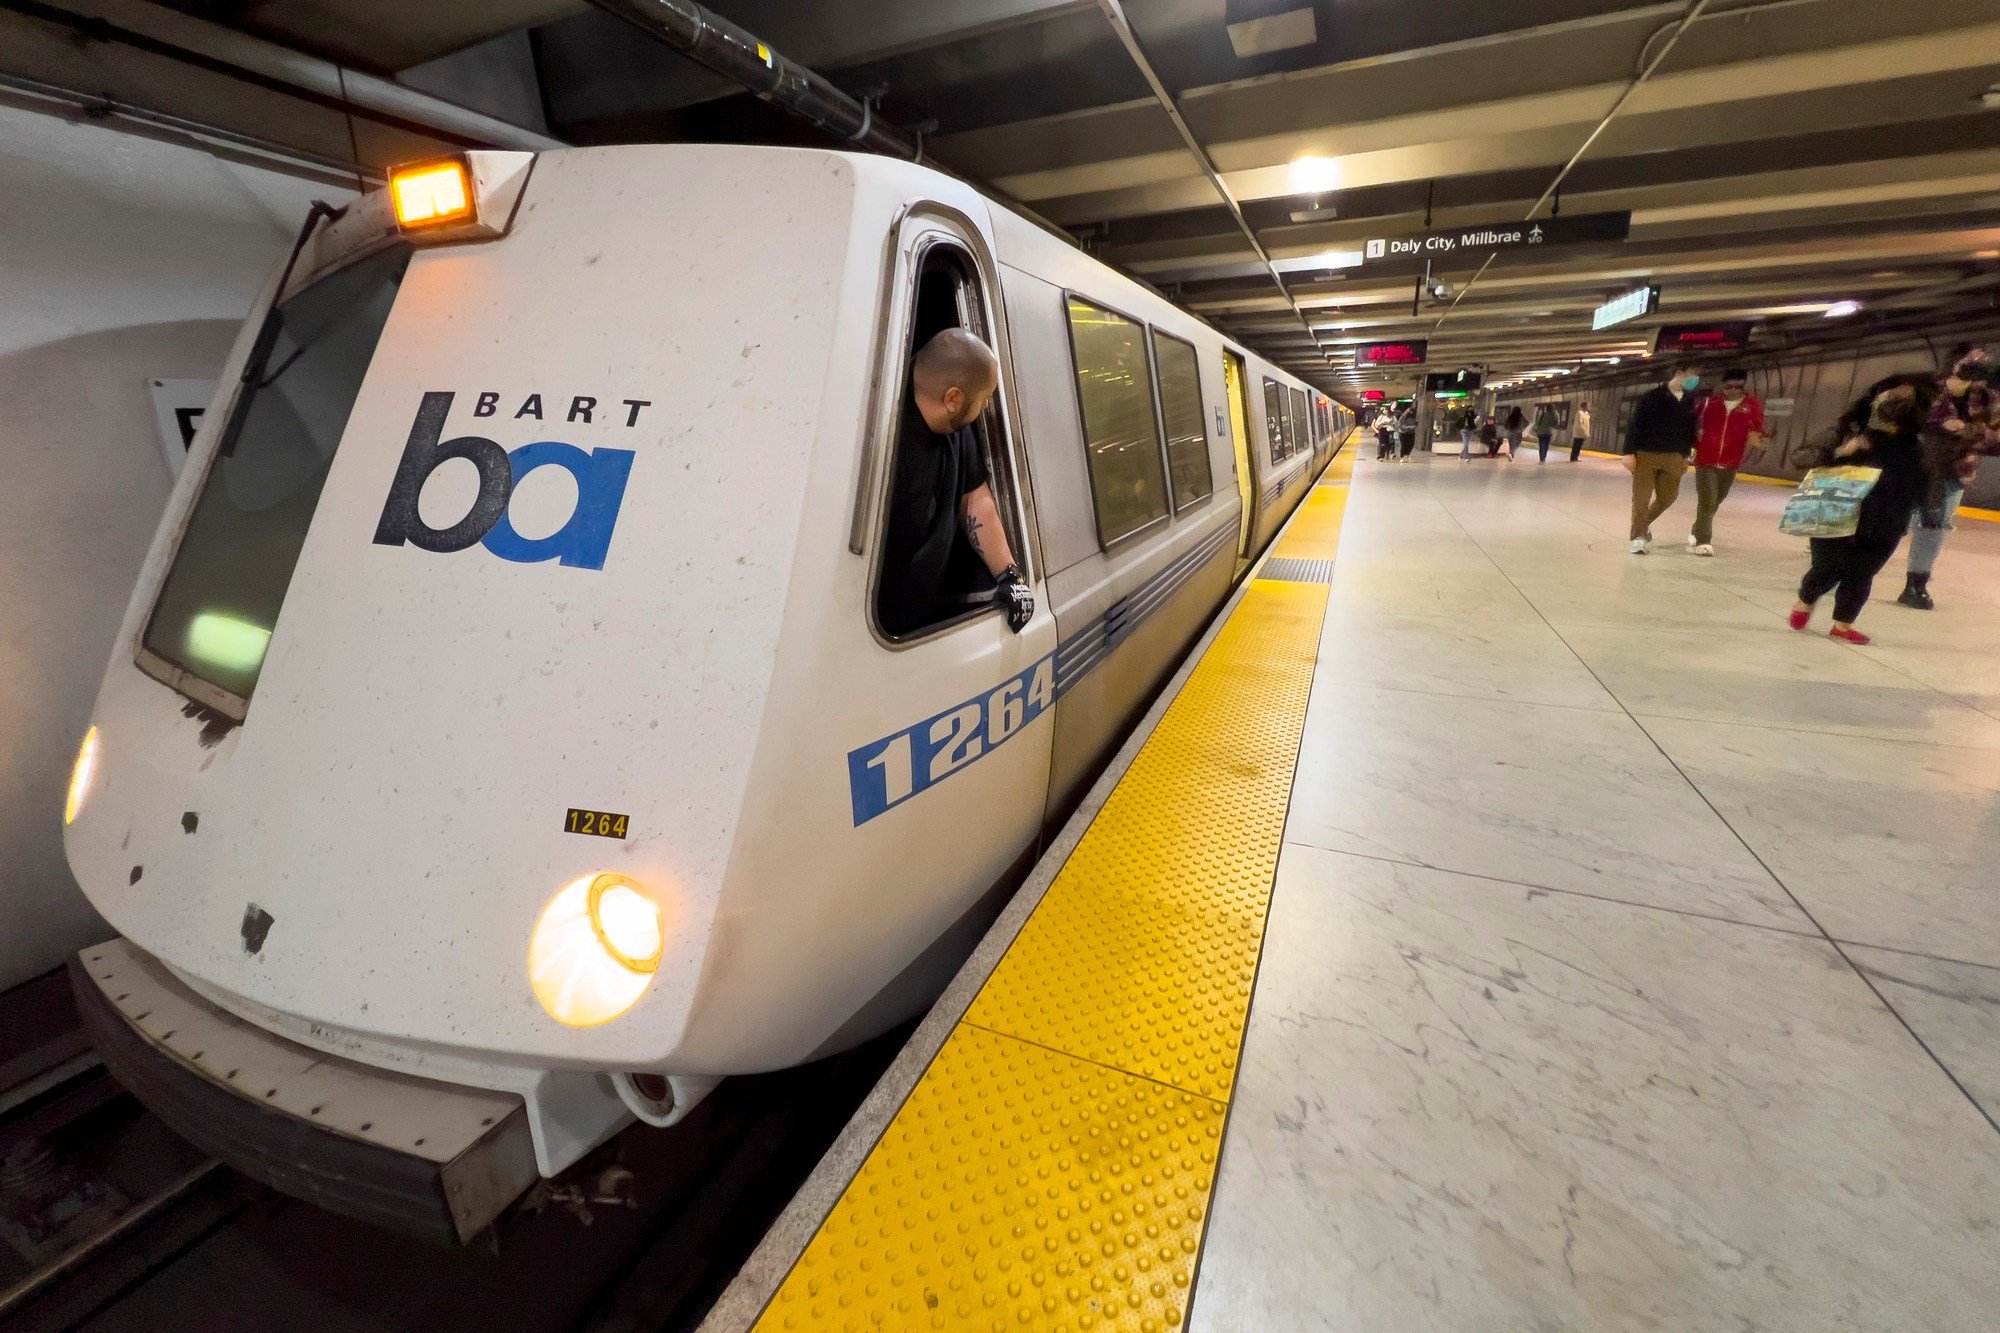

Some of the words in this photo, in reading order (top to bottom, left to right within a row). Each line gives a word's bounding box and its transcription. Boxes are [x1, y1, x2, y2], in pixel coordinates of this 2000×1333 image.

[1390, 238, 1422, 254] Daly
[1425, 236, 1456, 250] City,
[1461, 230, 1522, 247] Millbrae
[1528, 236, 1543, 244] SFO
[473, 391, 652, 428] BART
[372, 391, 636, 571] ba
[866, 655, 1056, 806] 1264
[570, 811, 626, 837] 1264
